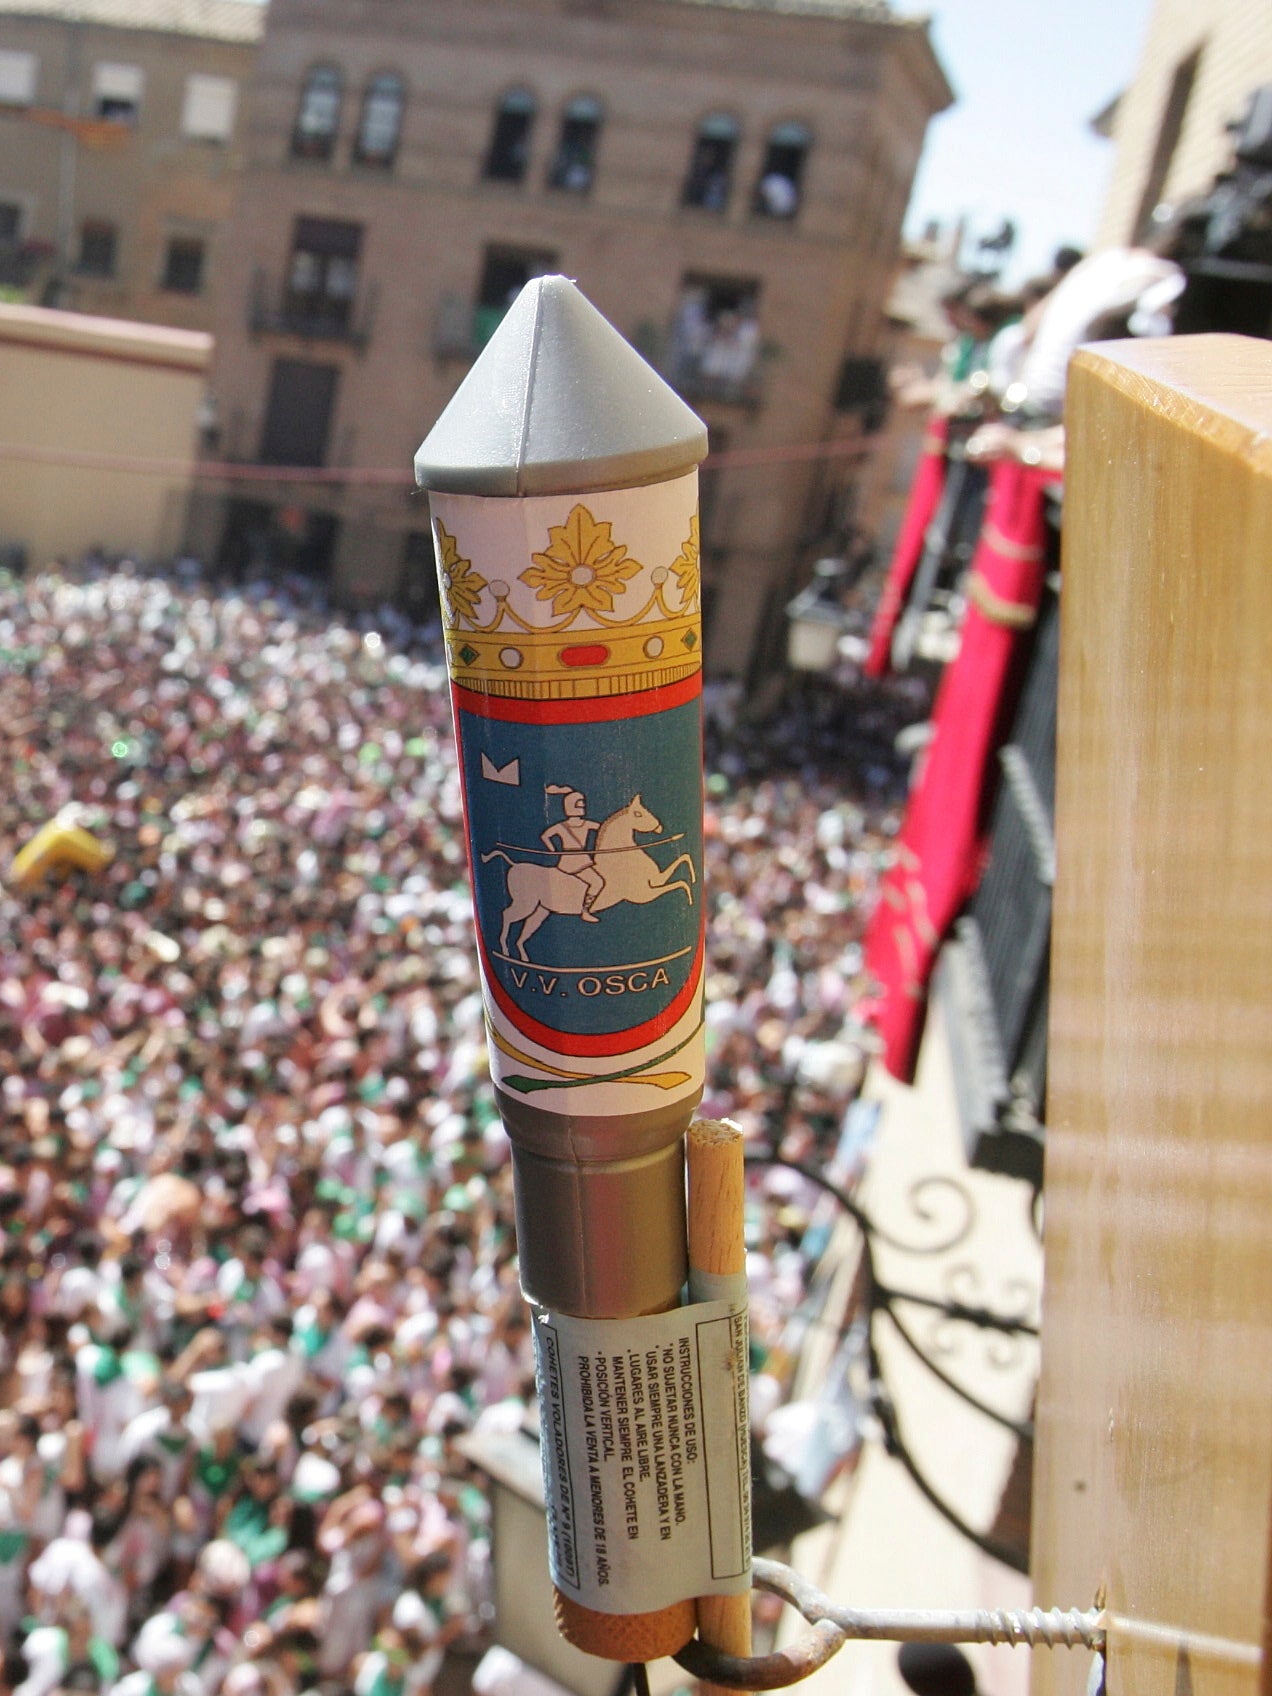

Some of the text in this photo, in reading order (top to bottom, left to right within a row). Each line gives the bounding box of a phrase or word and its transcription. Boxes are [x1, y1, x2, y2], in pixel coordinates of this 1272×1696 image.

[578, 967, 670, 997] OSCA
[546, 1337, 560, 1400] COHETES
[645, 1351, 657, 1380] USAR
[734, 1317, 742, 1337] SAN
[738, 1374, 744, 1388] DE
[595, 1357, 615, 1462] POSICIÓN VERTICAL.
[629, 1354, 650, 1482] LUGARES AL AIRE LIBRE.
[648, 1382, 662, 1429] SIEMPRE
[679, 1337, 698, 1464] INSTRUCCIONES DE USO:
[552, 1403, 568, 1482] VOLADORES
[612, 1356, 638, 1540] MANTENER SIEMPRE EL COHETE EN
[652, 1430, 664, 1453] UNA
[662, 1349, 686, 1526] NO SUJETAR NUNCA CON LA MANO.
[560, 1484, 570, 1504] DE
[578, 1356, 611, 1587] PROHIBIDA LA VENTA A MENORES DE 18 AÑOS.
[654, 1454, 670, 1516] LANZADERA
[660, 1526, 671, 1540] EN
